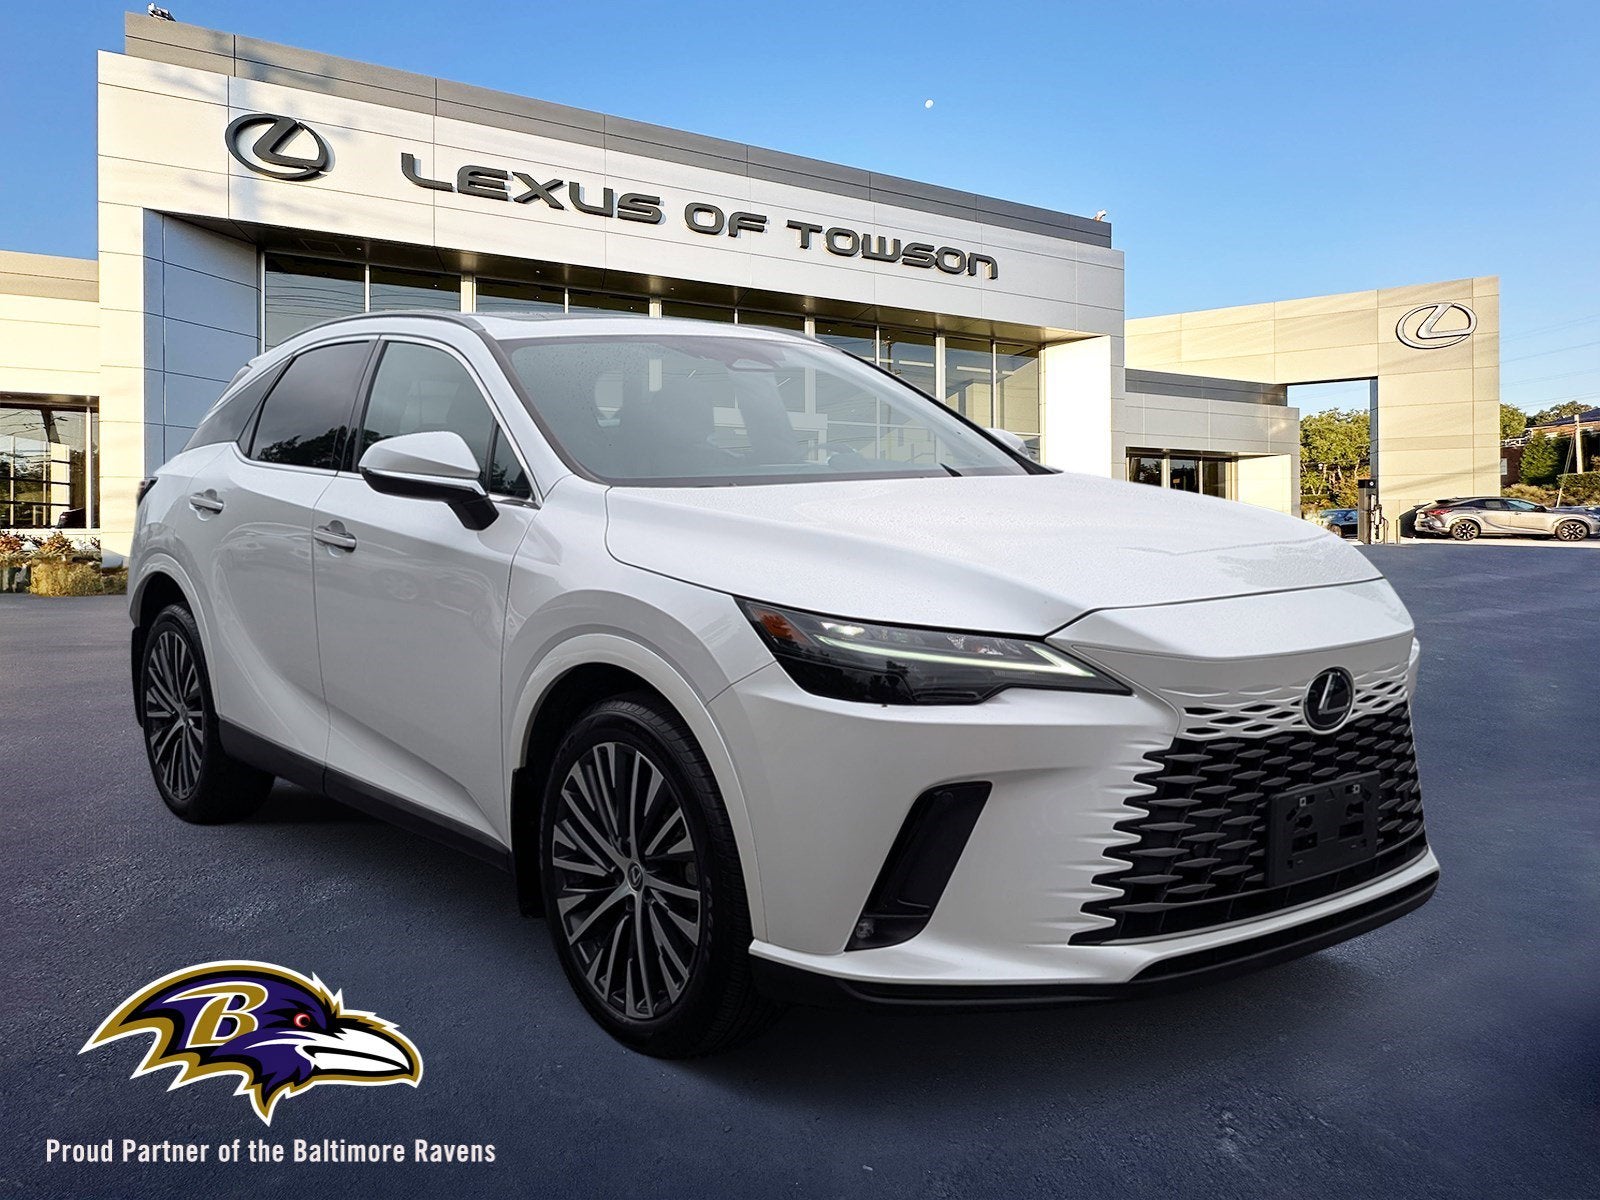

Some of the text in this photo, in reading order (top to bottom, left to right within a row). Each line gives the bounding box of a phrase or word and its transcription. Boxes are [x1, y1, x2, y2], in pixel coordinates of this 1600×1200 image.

[401, 152, 999, 281] LEXUS OF TOWSON
